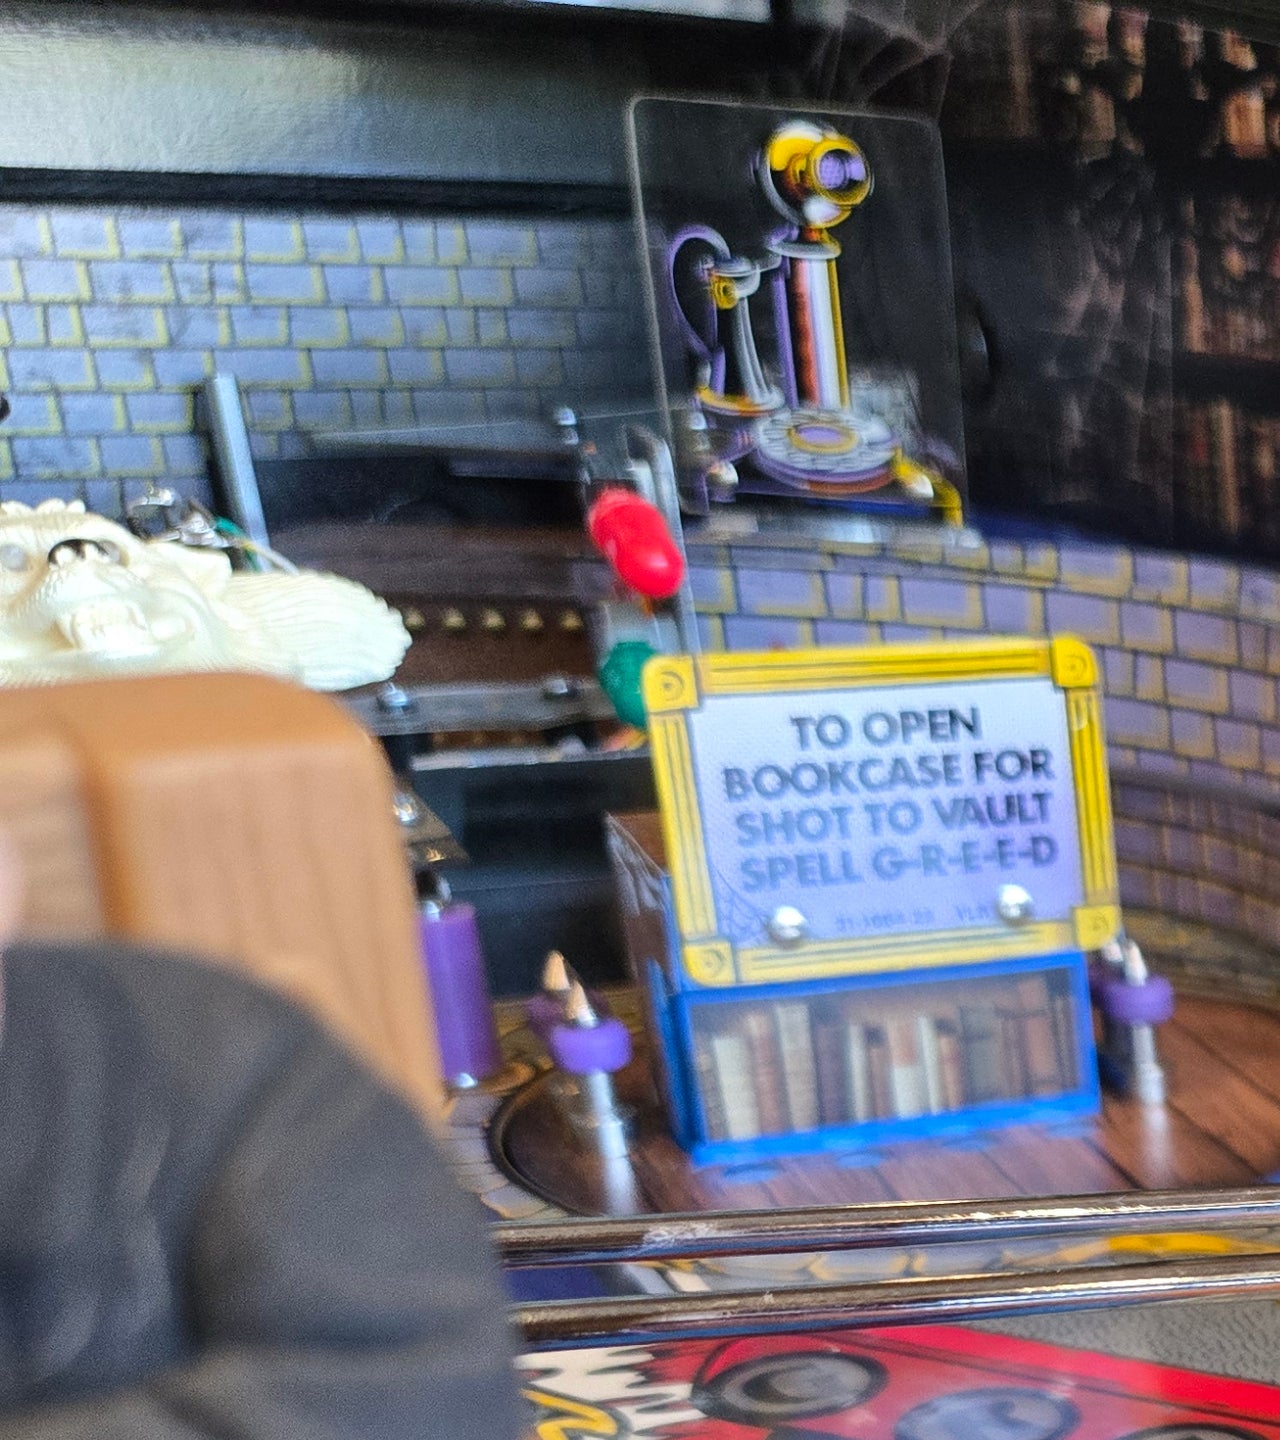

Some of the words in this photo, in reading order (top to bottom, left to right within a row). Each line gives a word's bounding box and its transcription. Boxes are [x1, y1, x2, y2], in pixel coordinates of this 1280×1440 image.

[791, 713, 851, 752] TO
[862, 706, 982, 744] OPEN
[723, 755, 963, 802] BOOKCASE
[974, 748, 1056, 784] FOR
[736, 805, 853, 848] SHOT
[863, 801, 924, 837] TO
[935, 792, 1054, 831] VAULT
[740, 850, 862, 893] SPELL
[872, 834, 1059, 881] G-R-E-E-D
